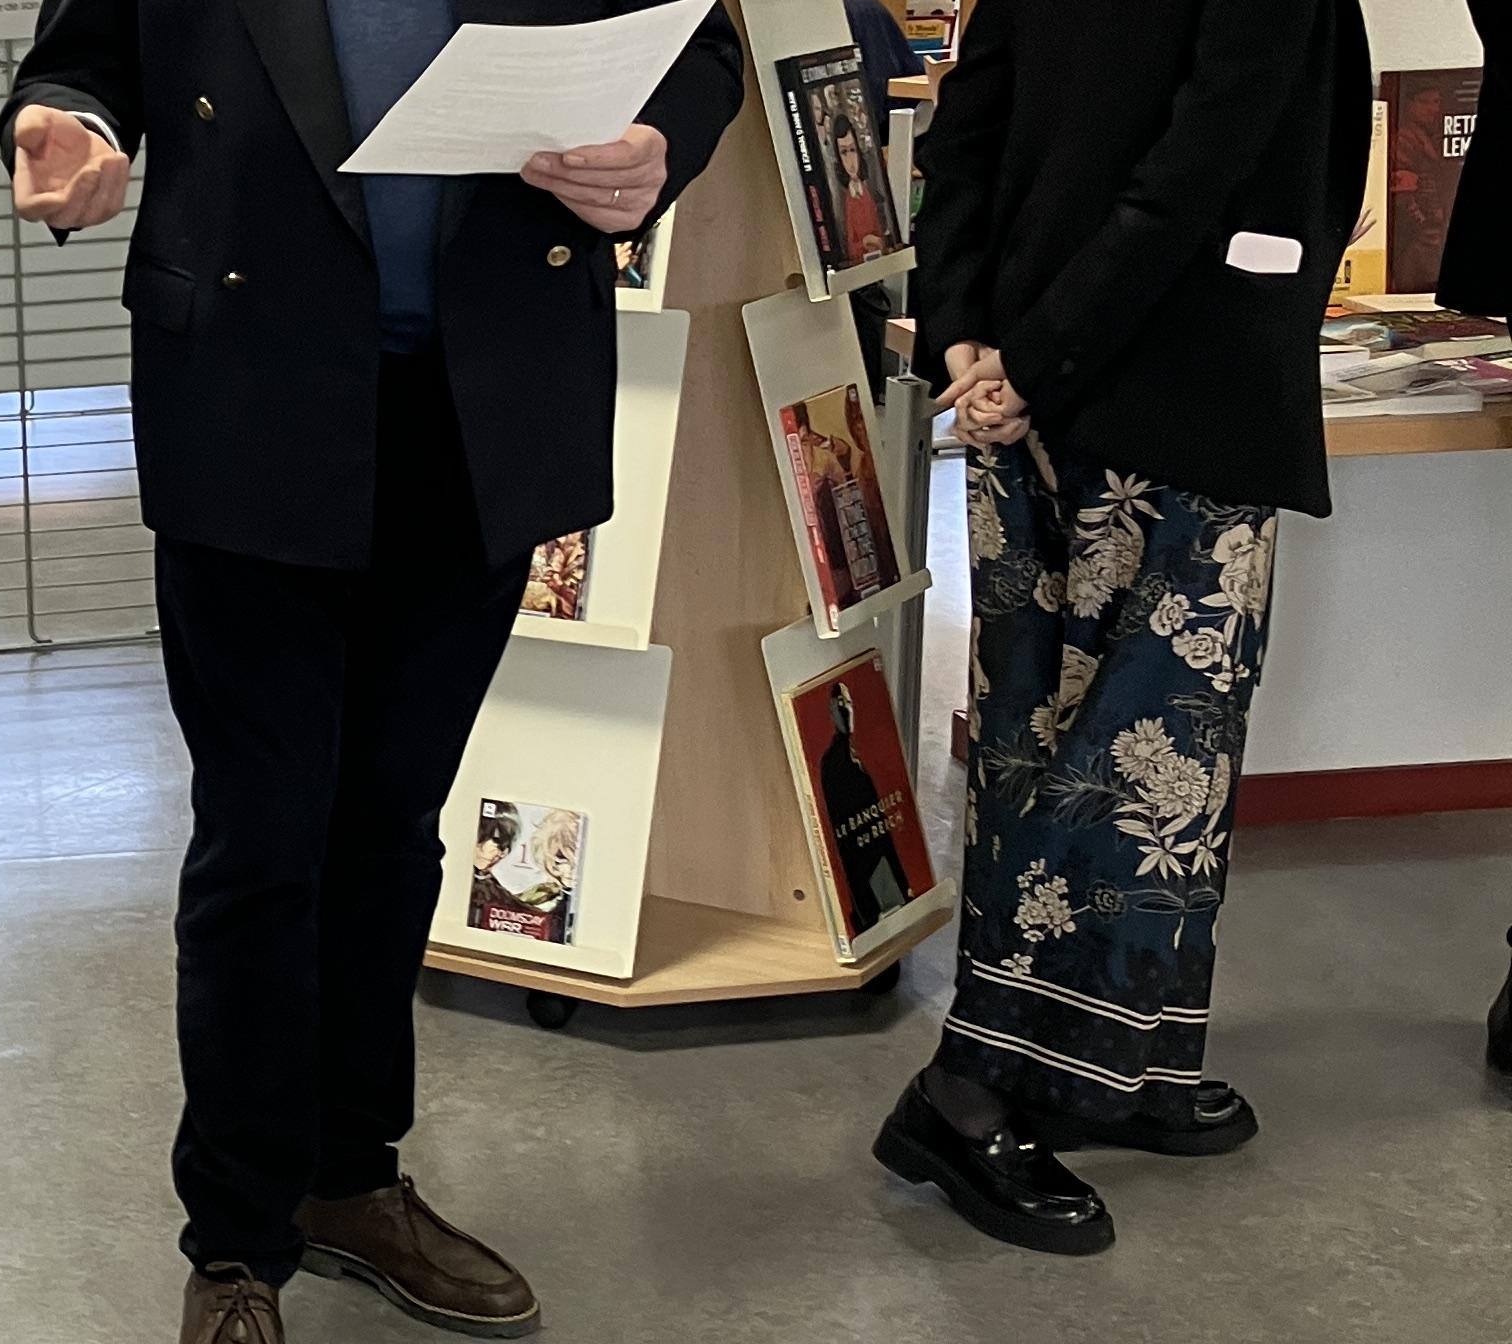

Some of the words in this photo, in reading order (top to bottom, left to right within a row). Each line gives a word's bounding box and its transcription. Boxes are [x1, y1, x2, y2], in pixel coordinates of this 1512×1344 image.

[835, 824, 848, 839] LE
[848, 790, 903, 831] BANQUIER
[521, 843, 528, 864] 1
[489, 907, 546, 924] DOOMSDAY
[489, 918, 522, 934] WAR
